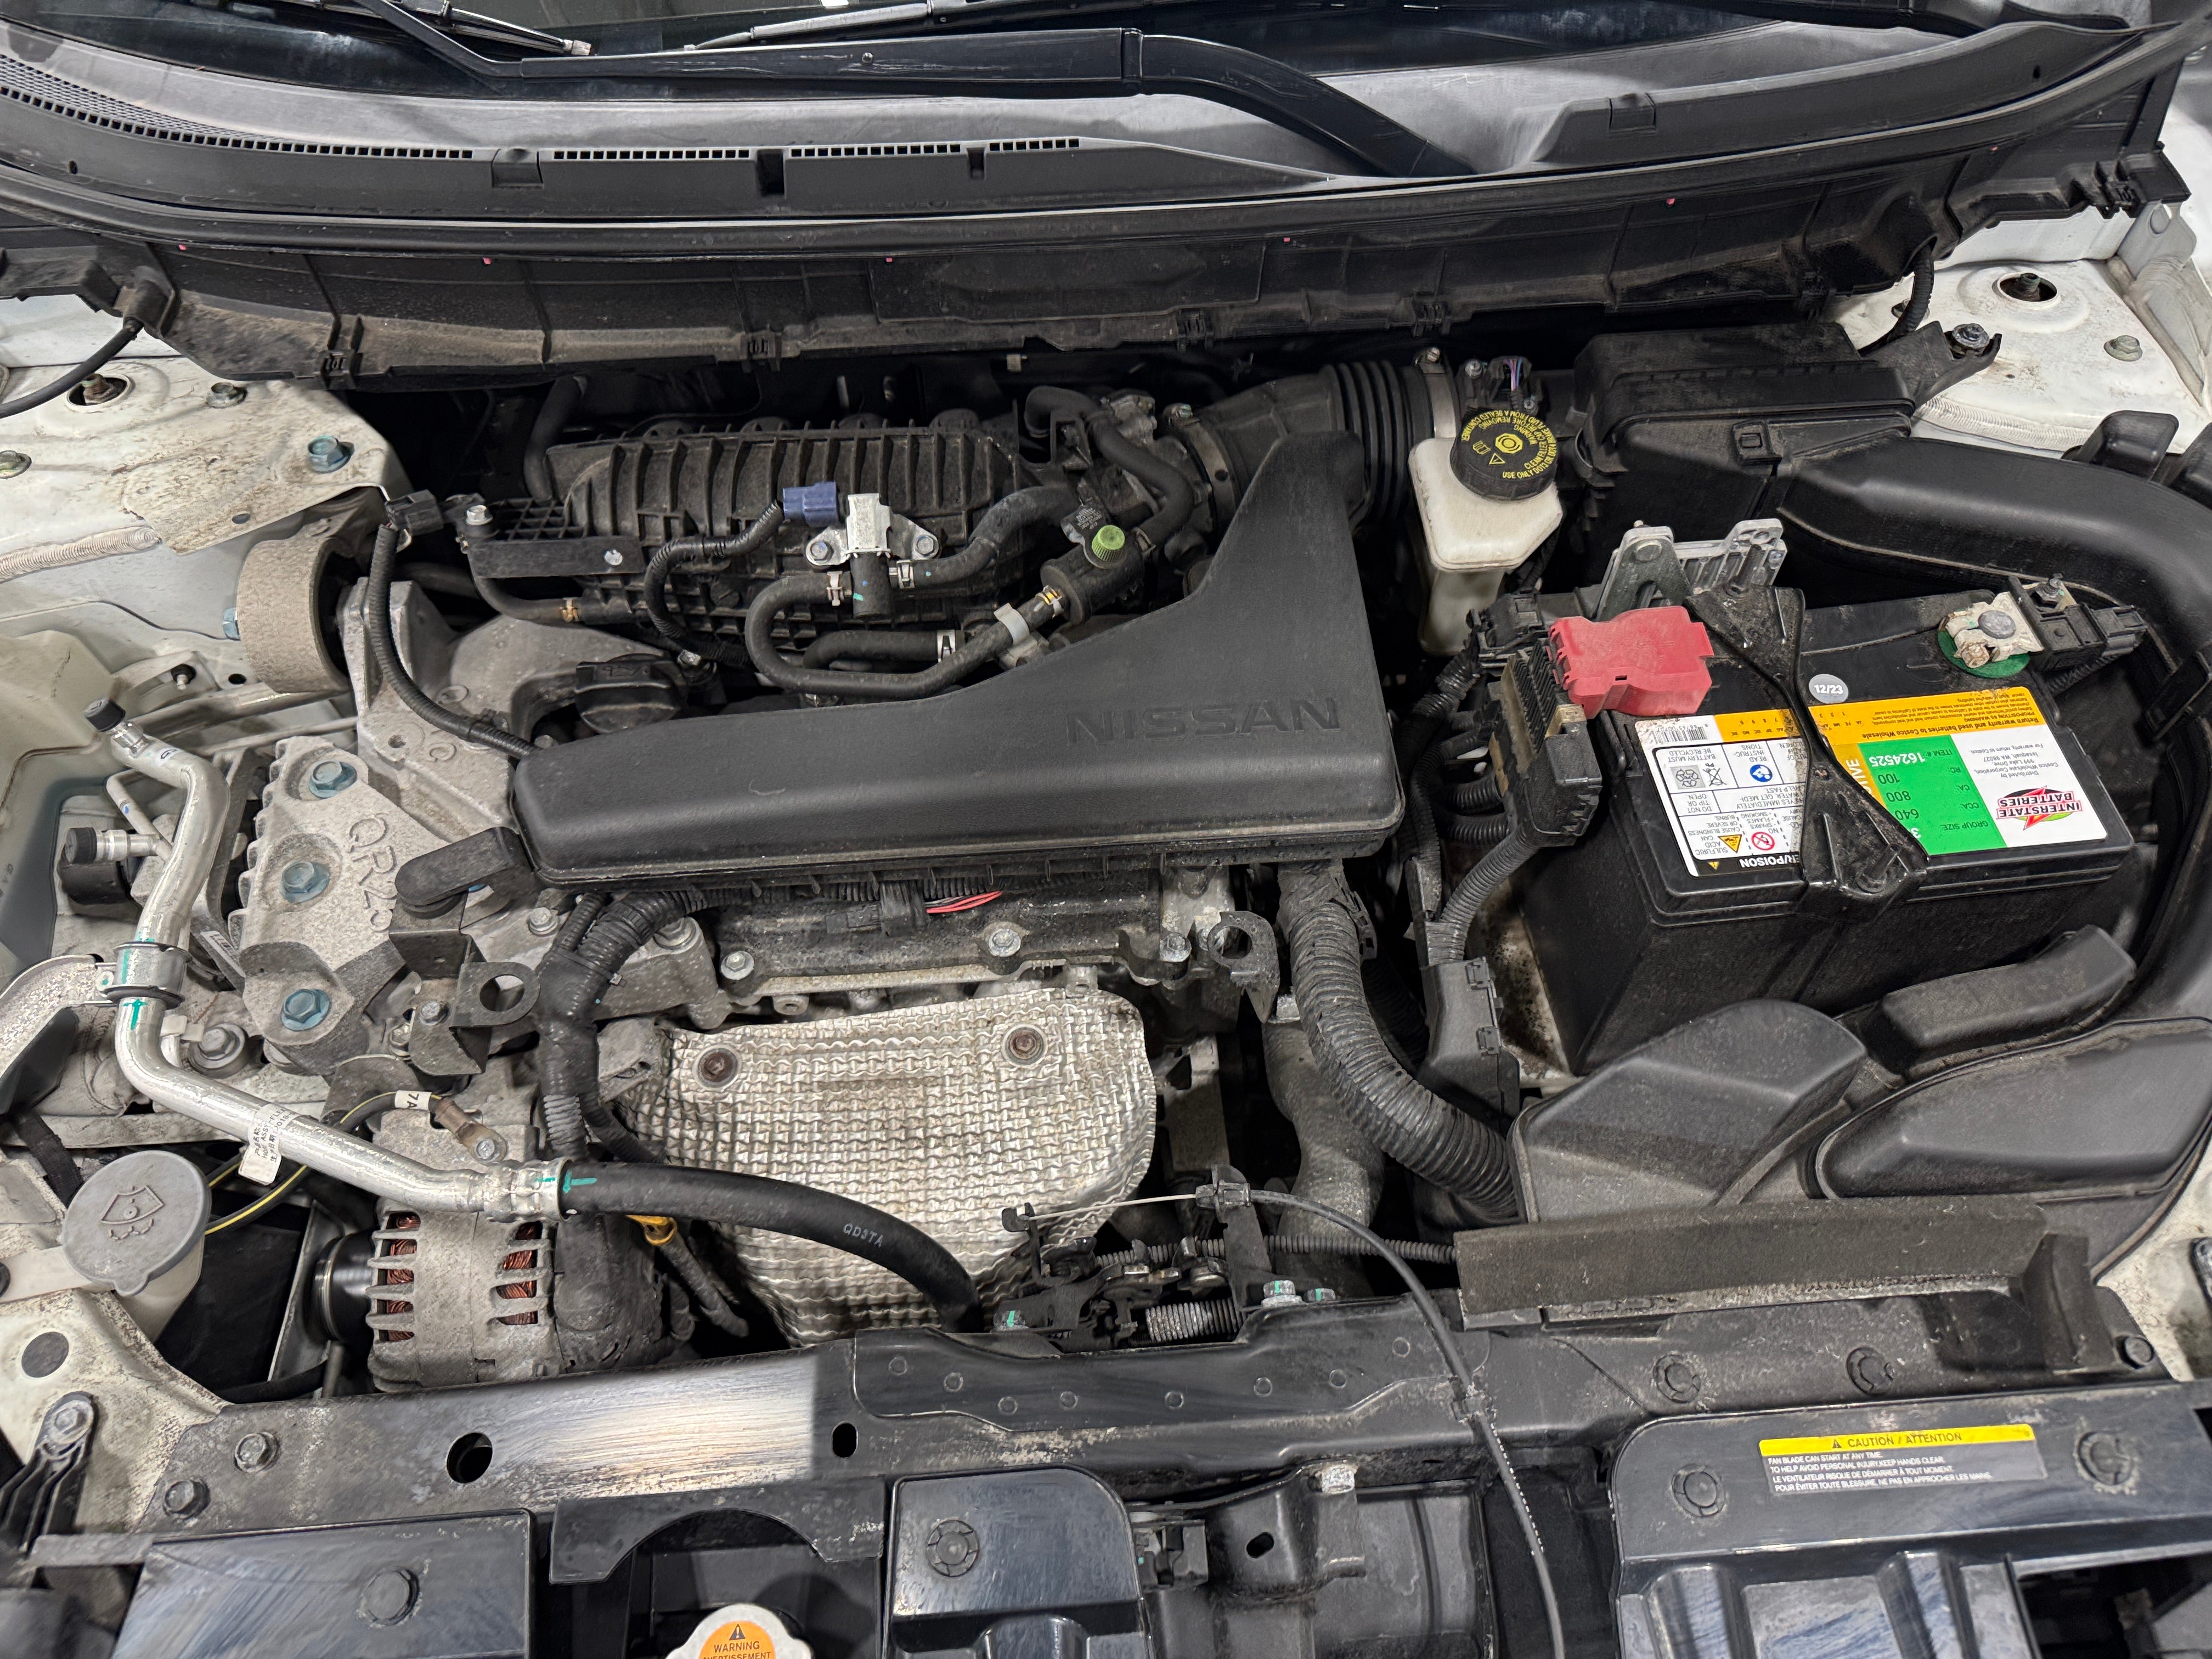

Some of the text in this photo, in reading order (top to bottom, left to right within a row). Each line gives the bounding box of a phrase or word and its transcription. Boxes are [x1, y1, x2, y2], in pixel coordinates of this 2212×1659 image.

[1480, 410, 1503, 420] SEALED
[1510, 410, 1529, 420] FROM
[1478, 417, 1510, 430] REMOVING
[1512, 417, 1537, 431] BEFORE
[1513, 425, 1538, 445] WARNING
[1517, 470, 1534, 478] ONLY
[1814, 684, 1843, 694] 12/23
[1066, 697, 1340, 746] NISSAN
[1869, 753, 1925, 767] 1624525
[1878, 774, 1900, 784] 100
[1886, 791, 1911, 802] 800
[2000, 793, 2072, 807] BATTERIES
[1736, 800, 1780, 809] IMMEDIATELY
[1999, 802, 2079, 817] INTERSTATE
[1895, 809, 1919, 820] 640
[1962, 820, 1988, 828] GROUP
[1848, 1436, 1894, 1447] CAUTION
[1906, 1432, 1962, 1444] ATTENTION
[1783, 1474, 1825, 1482] VENTILATEUR
[1775, 1483, 1795, 1493] POUR
[714, 1641, 760, 1653] WARNING
